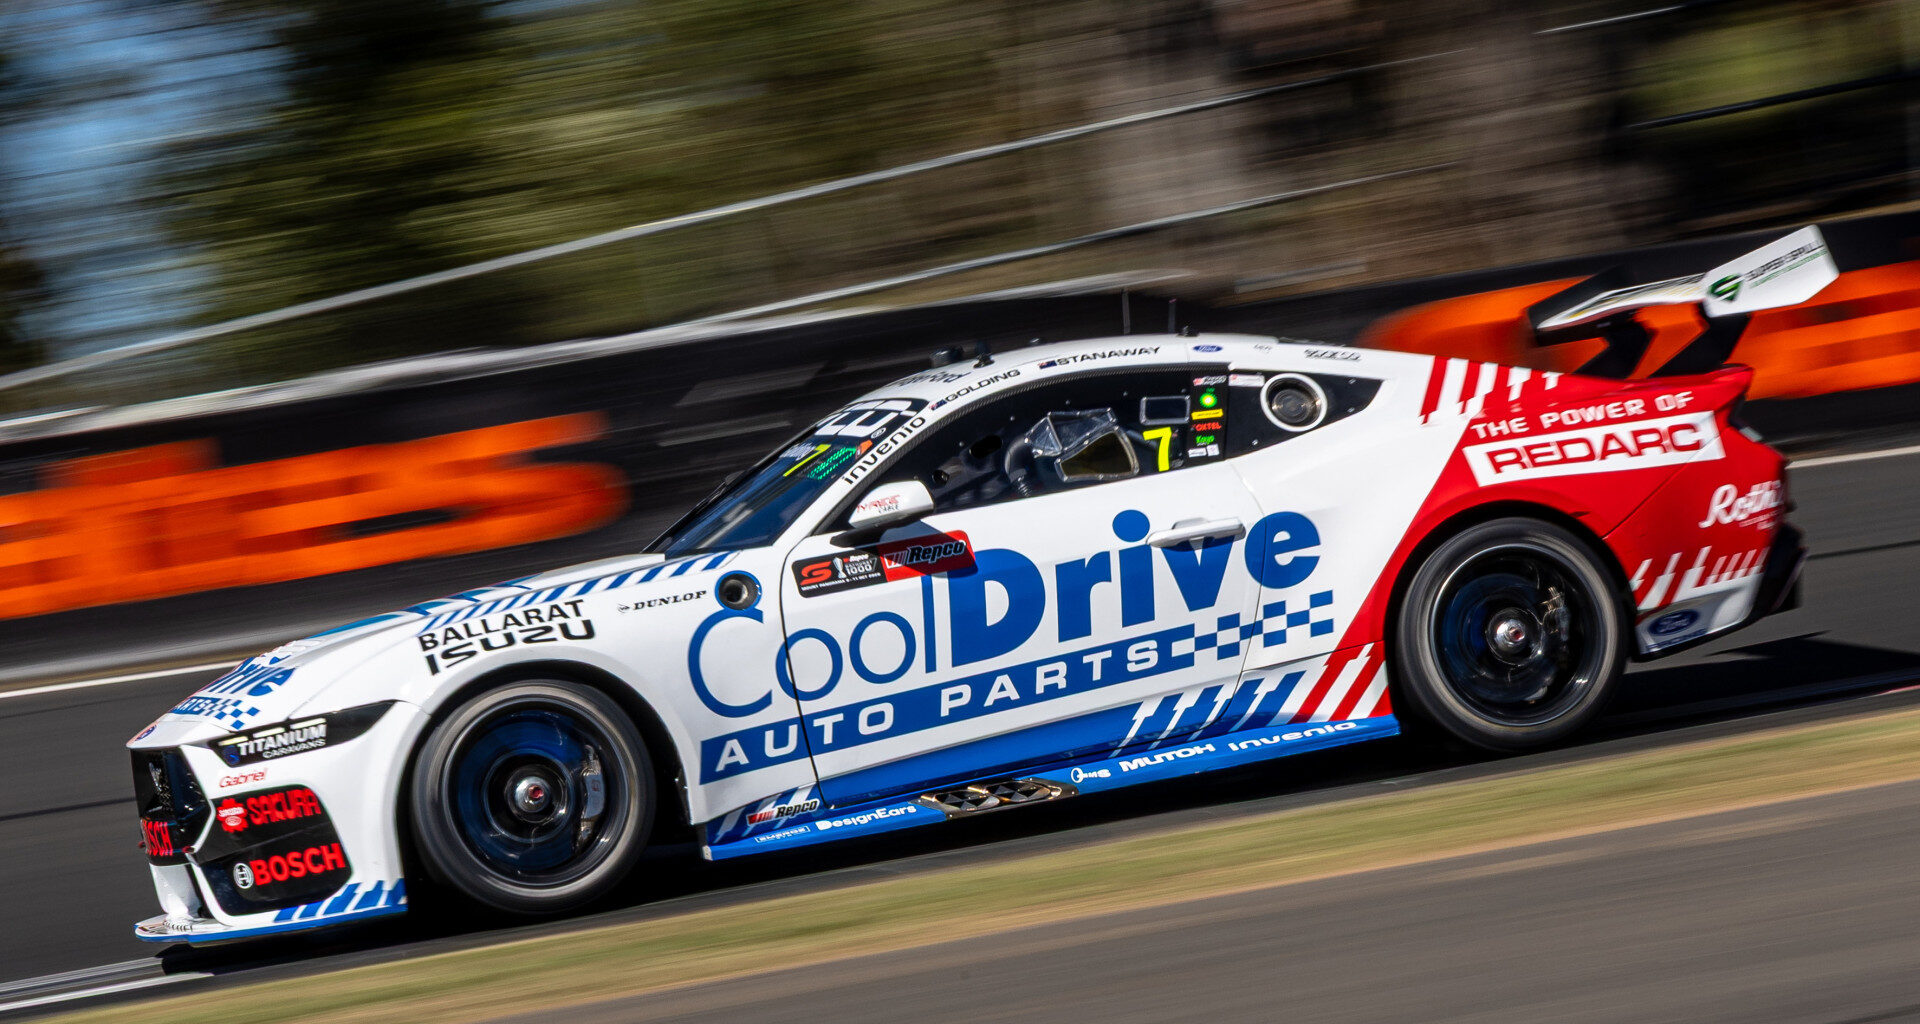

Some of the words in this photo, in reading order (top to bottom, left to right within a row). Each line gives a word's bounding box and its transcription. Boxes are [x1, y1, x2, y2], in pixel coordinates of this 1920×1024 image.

[1056, 347, 1160, 366] STANAWAY
[945, 369, 1020, 402] GOLDING
[1471, 417, 1529, 439] THE
[1540, 399, 1645, 429] POWER
[1655, 391, 1694, 412] OF
[841, 416, 926, 485] invenio
[1143, 427, 1172, 471] 7
[1486, 422, 1702, 475] REDARC
[908, 541, 967, 564] Repco
[847, 564, 872, 575] 1000
[634, 590, 706, 610] DUNLOP
[418, 599, 584, 651] BALLARAT
[425, 619, 595, 676] ISUZU
[716, 702, 894, 771] AUTO
[940, 640, 1158, 717] PARTS
[237, 724, 326, 756] TITANIUM
[262, 739, 326, 759] CARAVANS
[1119, 743, 1215, 772] MUTOH
[219, 768, 268, 788] Gabriel
[247, 788, 321, 825] SAKURA
[776, 798, 819, 819] Repco
[815, 804, 916, 831] DesignEars
[250, 842, 345, 887] BOSCH
